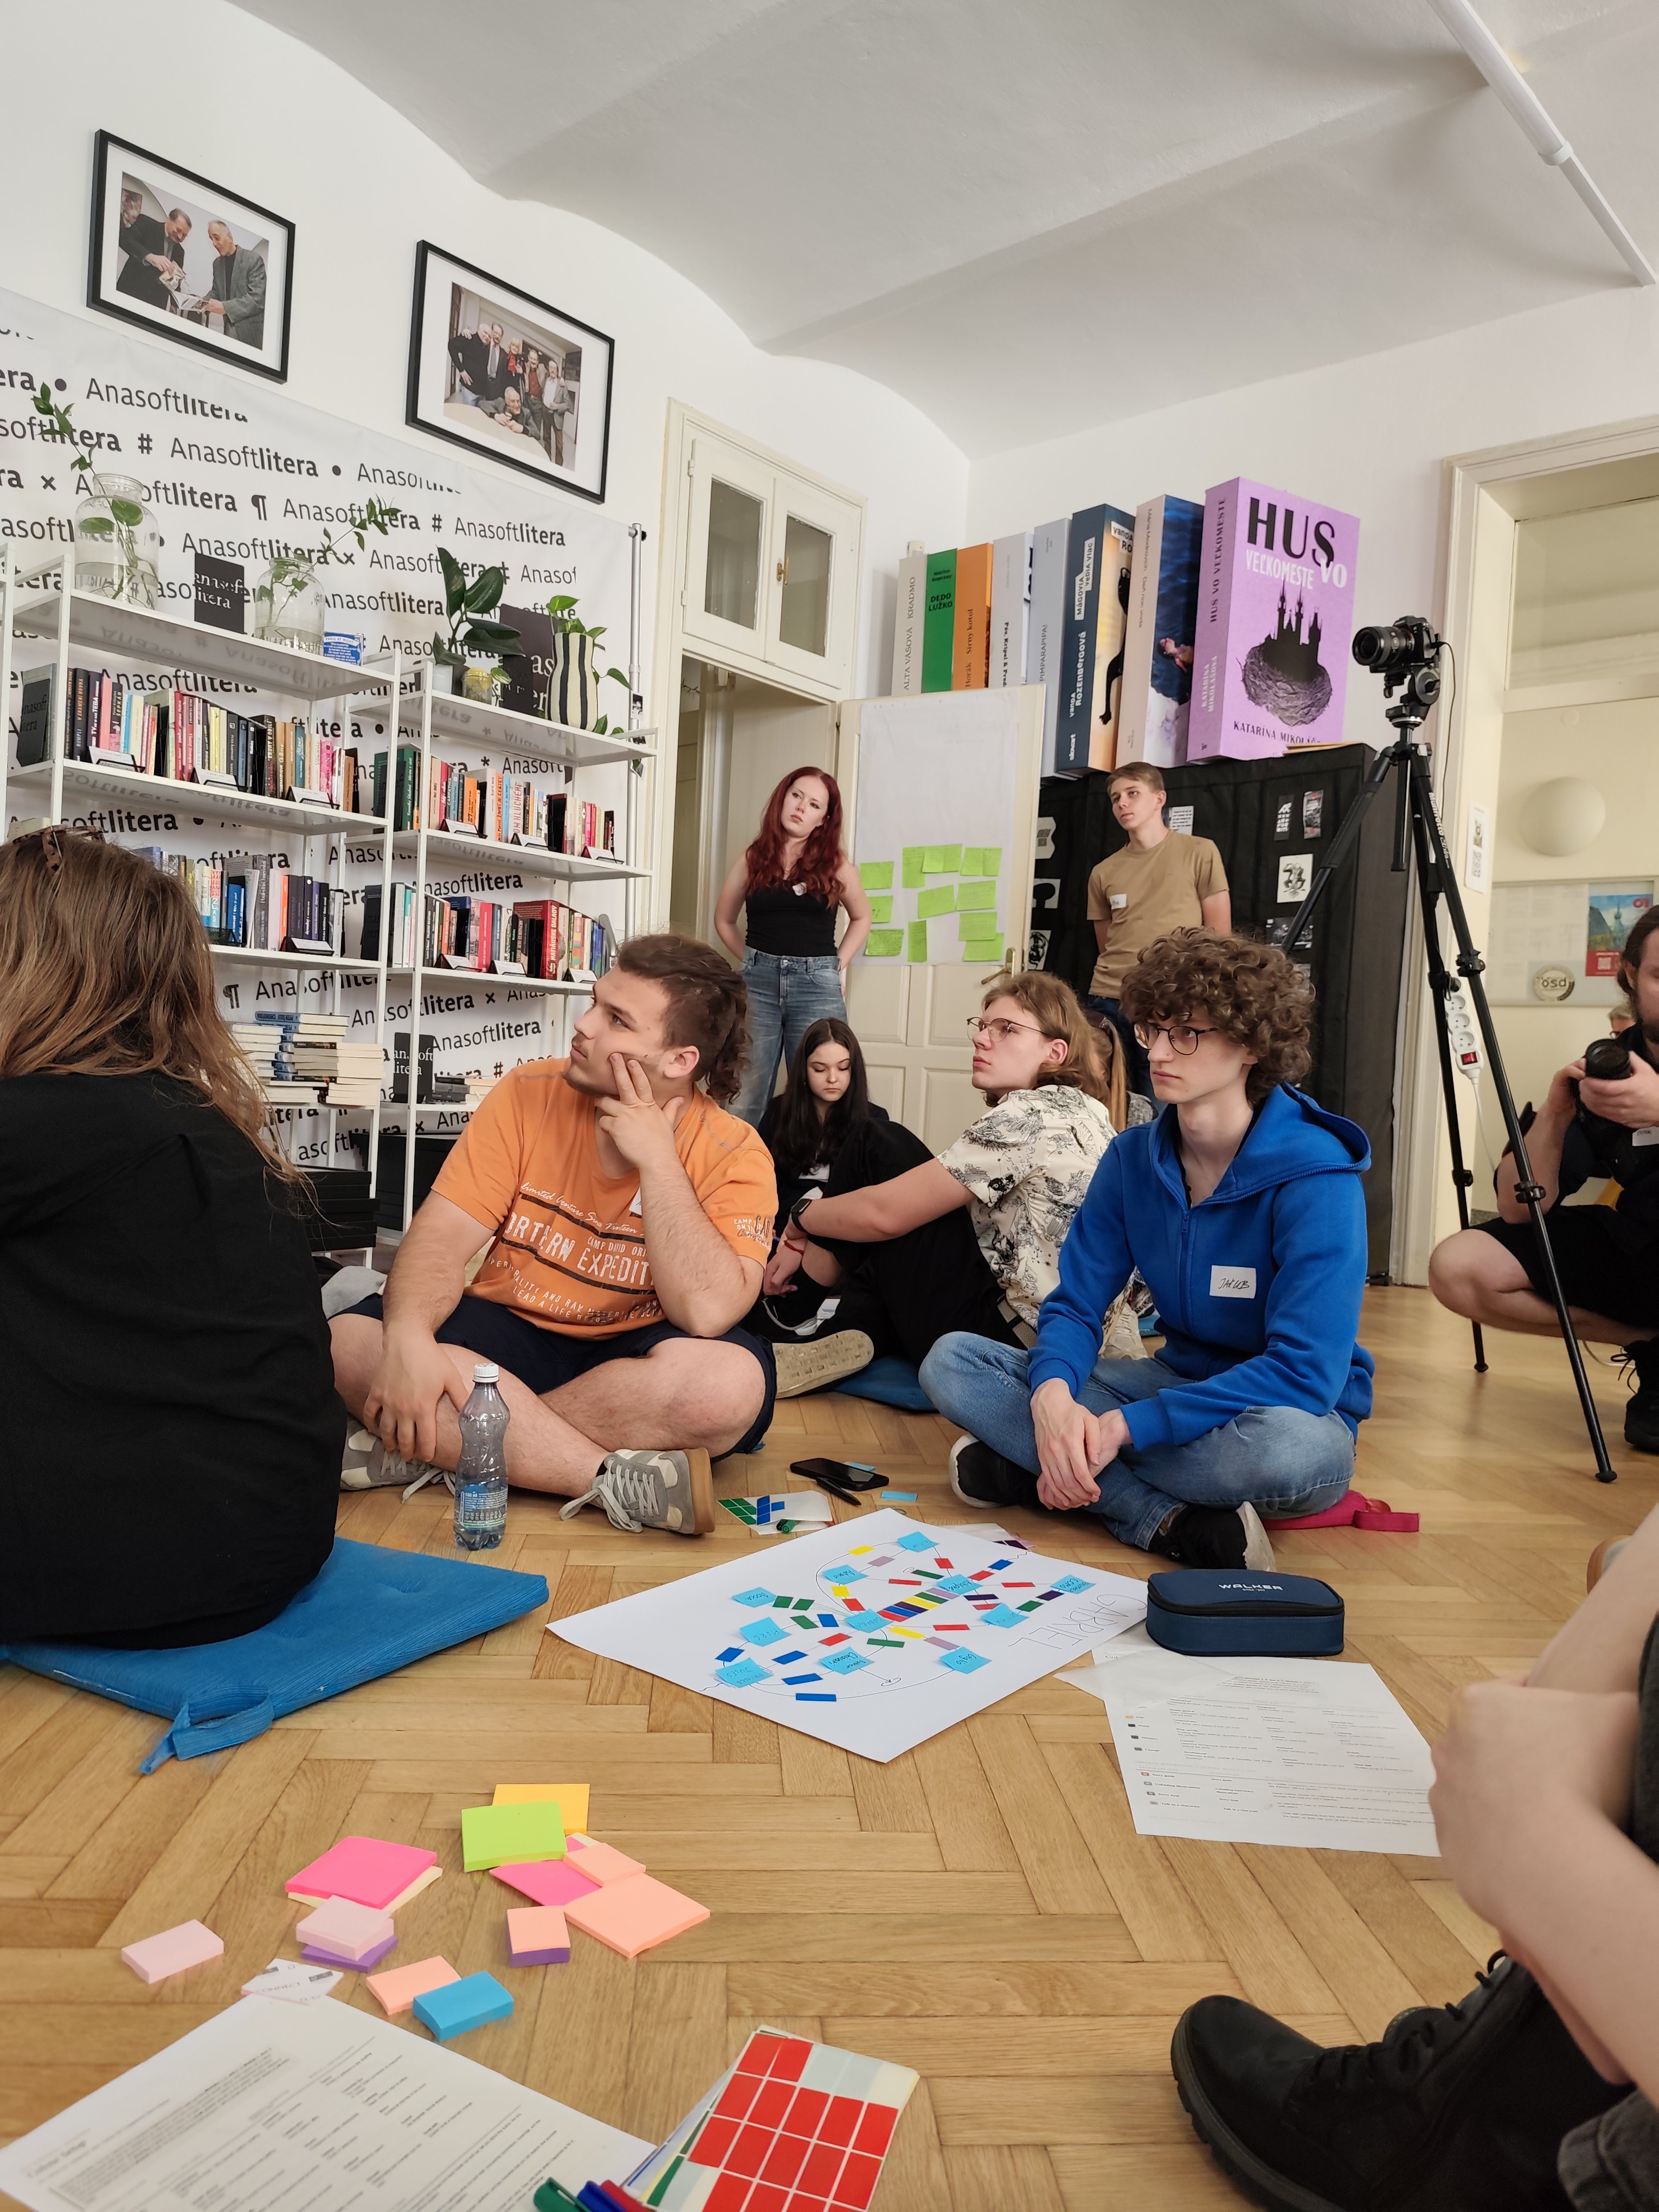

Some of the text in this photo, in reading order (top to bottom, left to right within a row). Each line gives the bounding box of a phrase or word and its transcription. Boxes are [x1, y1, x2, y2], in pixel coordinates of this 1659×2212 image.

[170, 438, 318, 477] Anasoftlitera
[75, 474, 237, 512] Aoftlitera
[455, 517, 565, 546] Anasoftlitera
[1247, 497, 1335, 568] HUS
[1213, 578, 1220, 595] VO
[1320, 558, 1348, 588] VO
[929, 601, 953, 612] LUŽKO
[931, 593, 951, 602] DEDO
[1210, 599, 1218, 623] HUS
[1234, 721, 1276, 740] KATARÍNA
[352, 994, 474, 1027] Ansoftlitera
[588, 1236, 606, 1251] CAMP
[608, 1243, 626, 1253] DAVID
[577, 1248, 654, 1286] EXPEDIT
[513, 1286, 536, 1303] LEAD
[549, 1303, 571, 1317] LIFE
[543, 1291, 562, 1303] AND
[1007, 1593, 1147, 1650] GABRIEL
